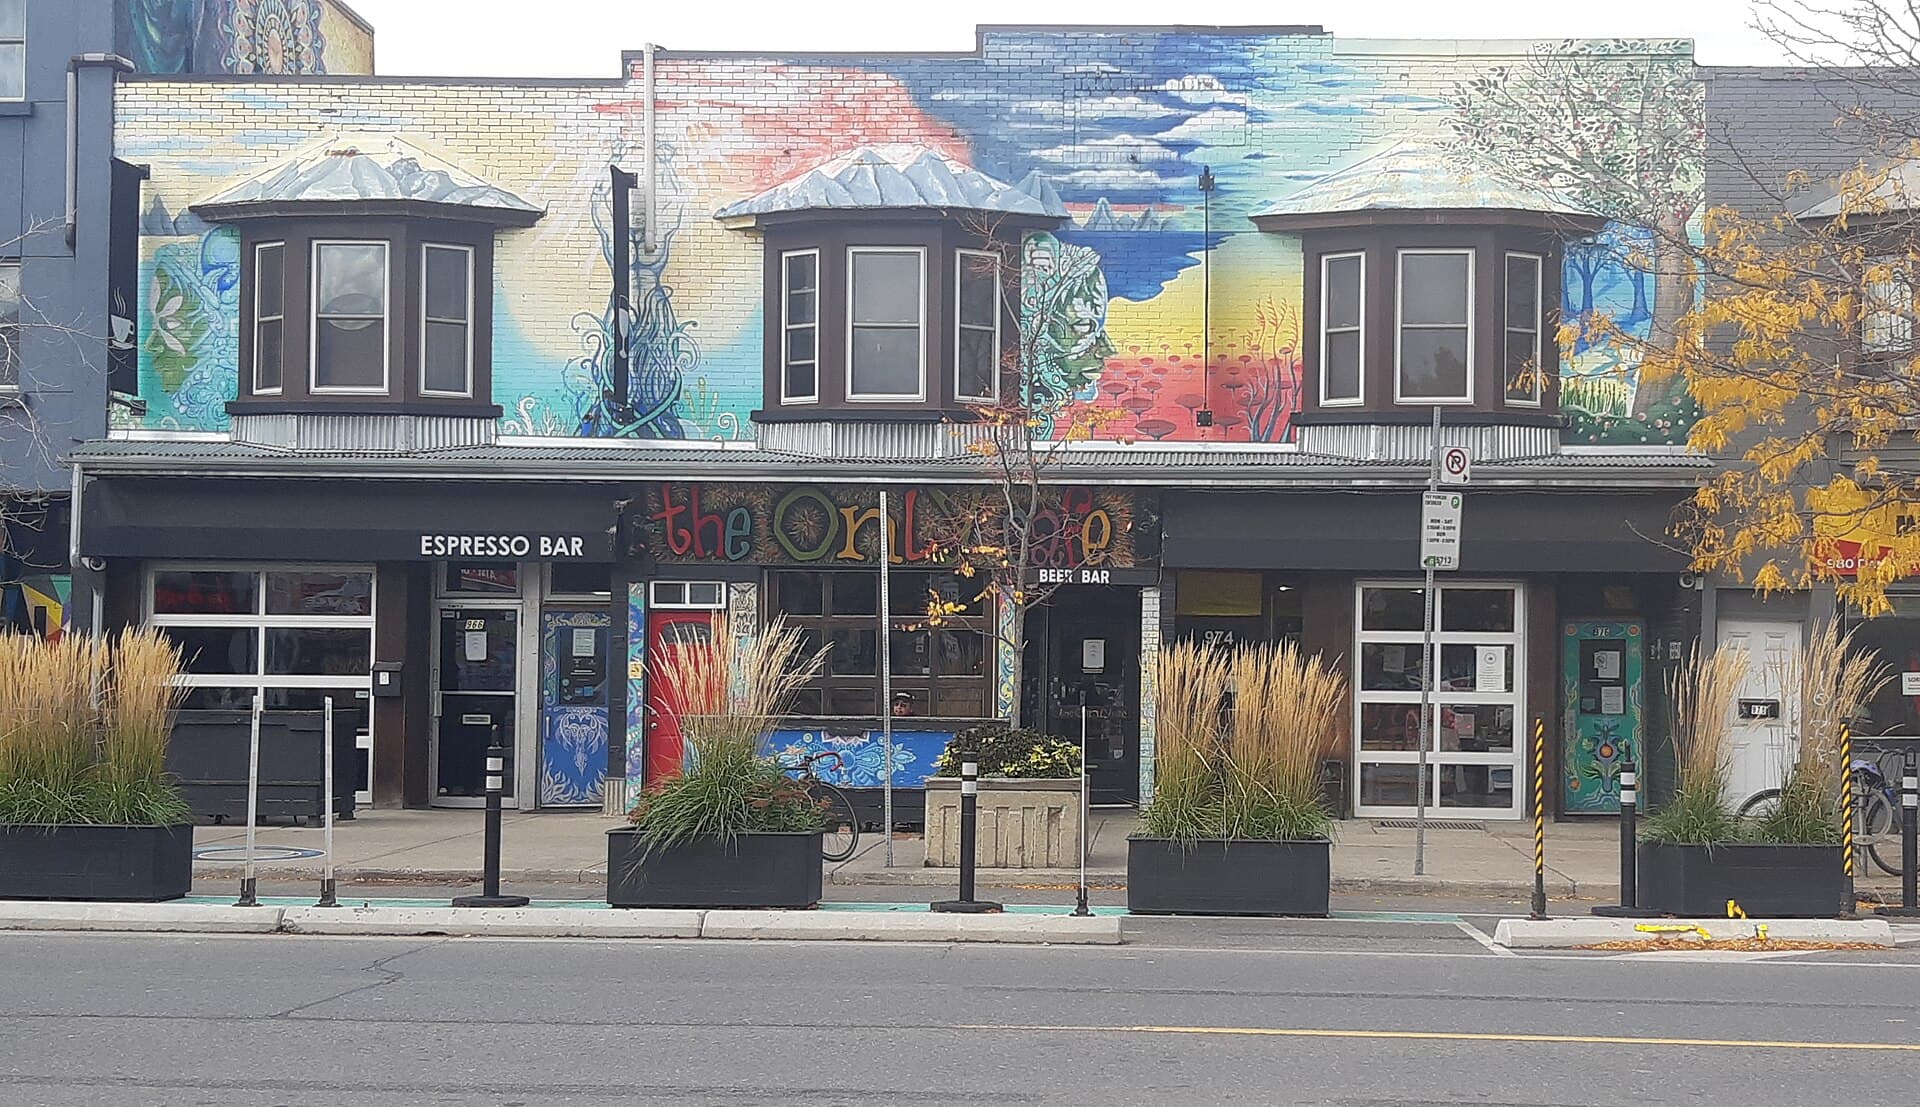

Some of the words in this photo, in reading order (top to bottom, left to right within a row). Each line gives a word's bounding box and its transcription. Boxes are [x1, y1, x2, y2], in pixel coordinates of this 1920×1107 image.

[652, 484, 751, 560] the
[421, 535, 530, 556] ESPRESSO
[540, 536, 583, 556] BAR
[1039, 569, 1073, 583] BEER
[1082, 569, 1110, 584] BAR
[465, 619, 485, 630] 966
[1204, 631, 1234, 645] 974
